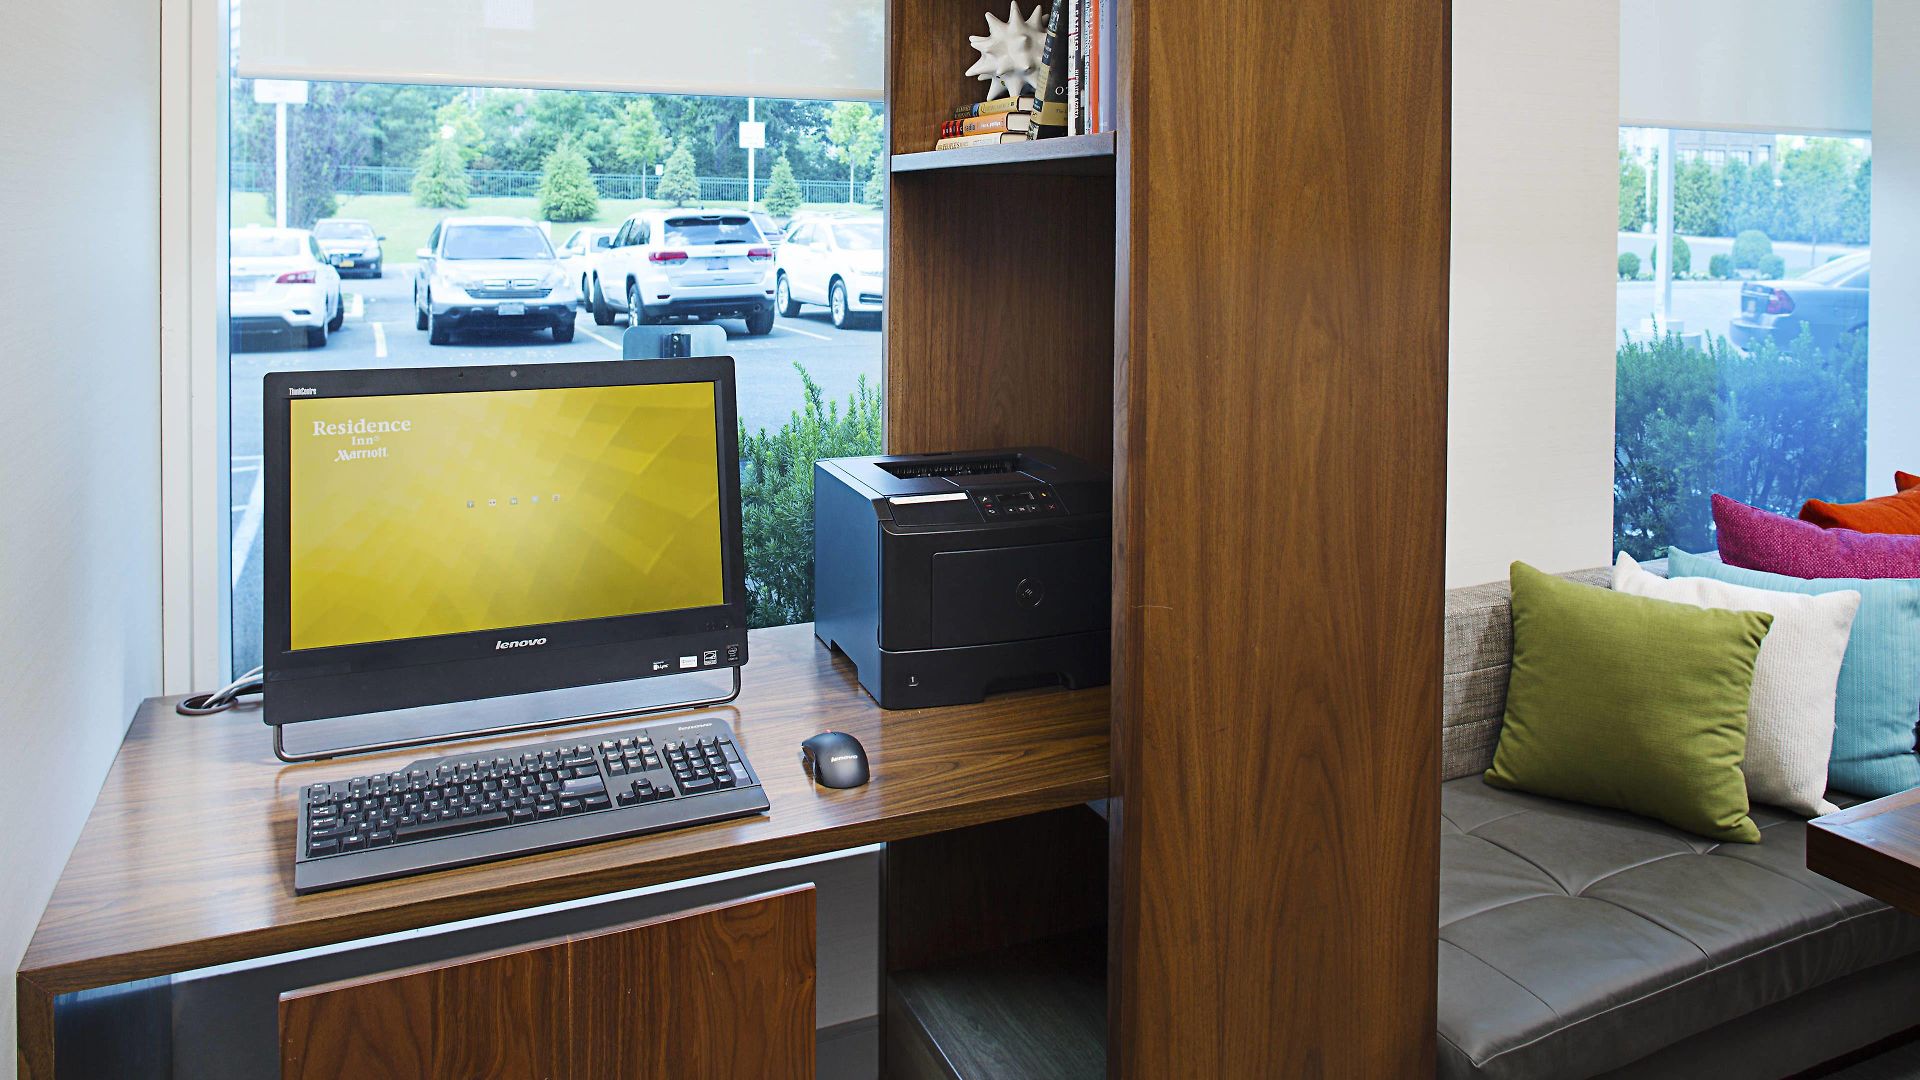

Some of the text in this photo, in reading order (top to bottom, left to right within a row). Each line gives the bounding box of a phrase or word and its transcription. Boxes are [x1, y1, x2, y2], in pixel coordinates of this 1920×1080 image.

[312, 418, 412, 436] Residence
[334, 447, 388, 462] Marriott
[495, 637, 547, 650] lenovo
[677, 722, 713, 731] lenovo
[830, 754, 858, 763] lenovo
